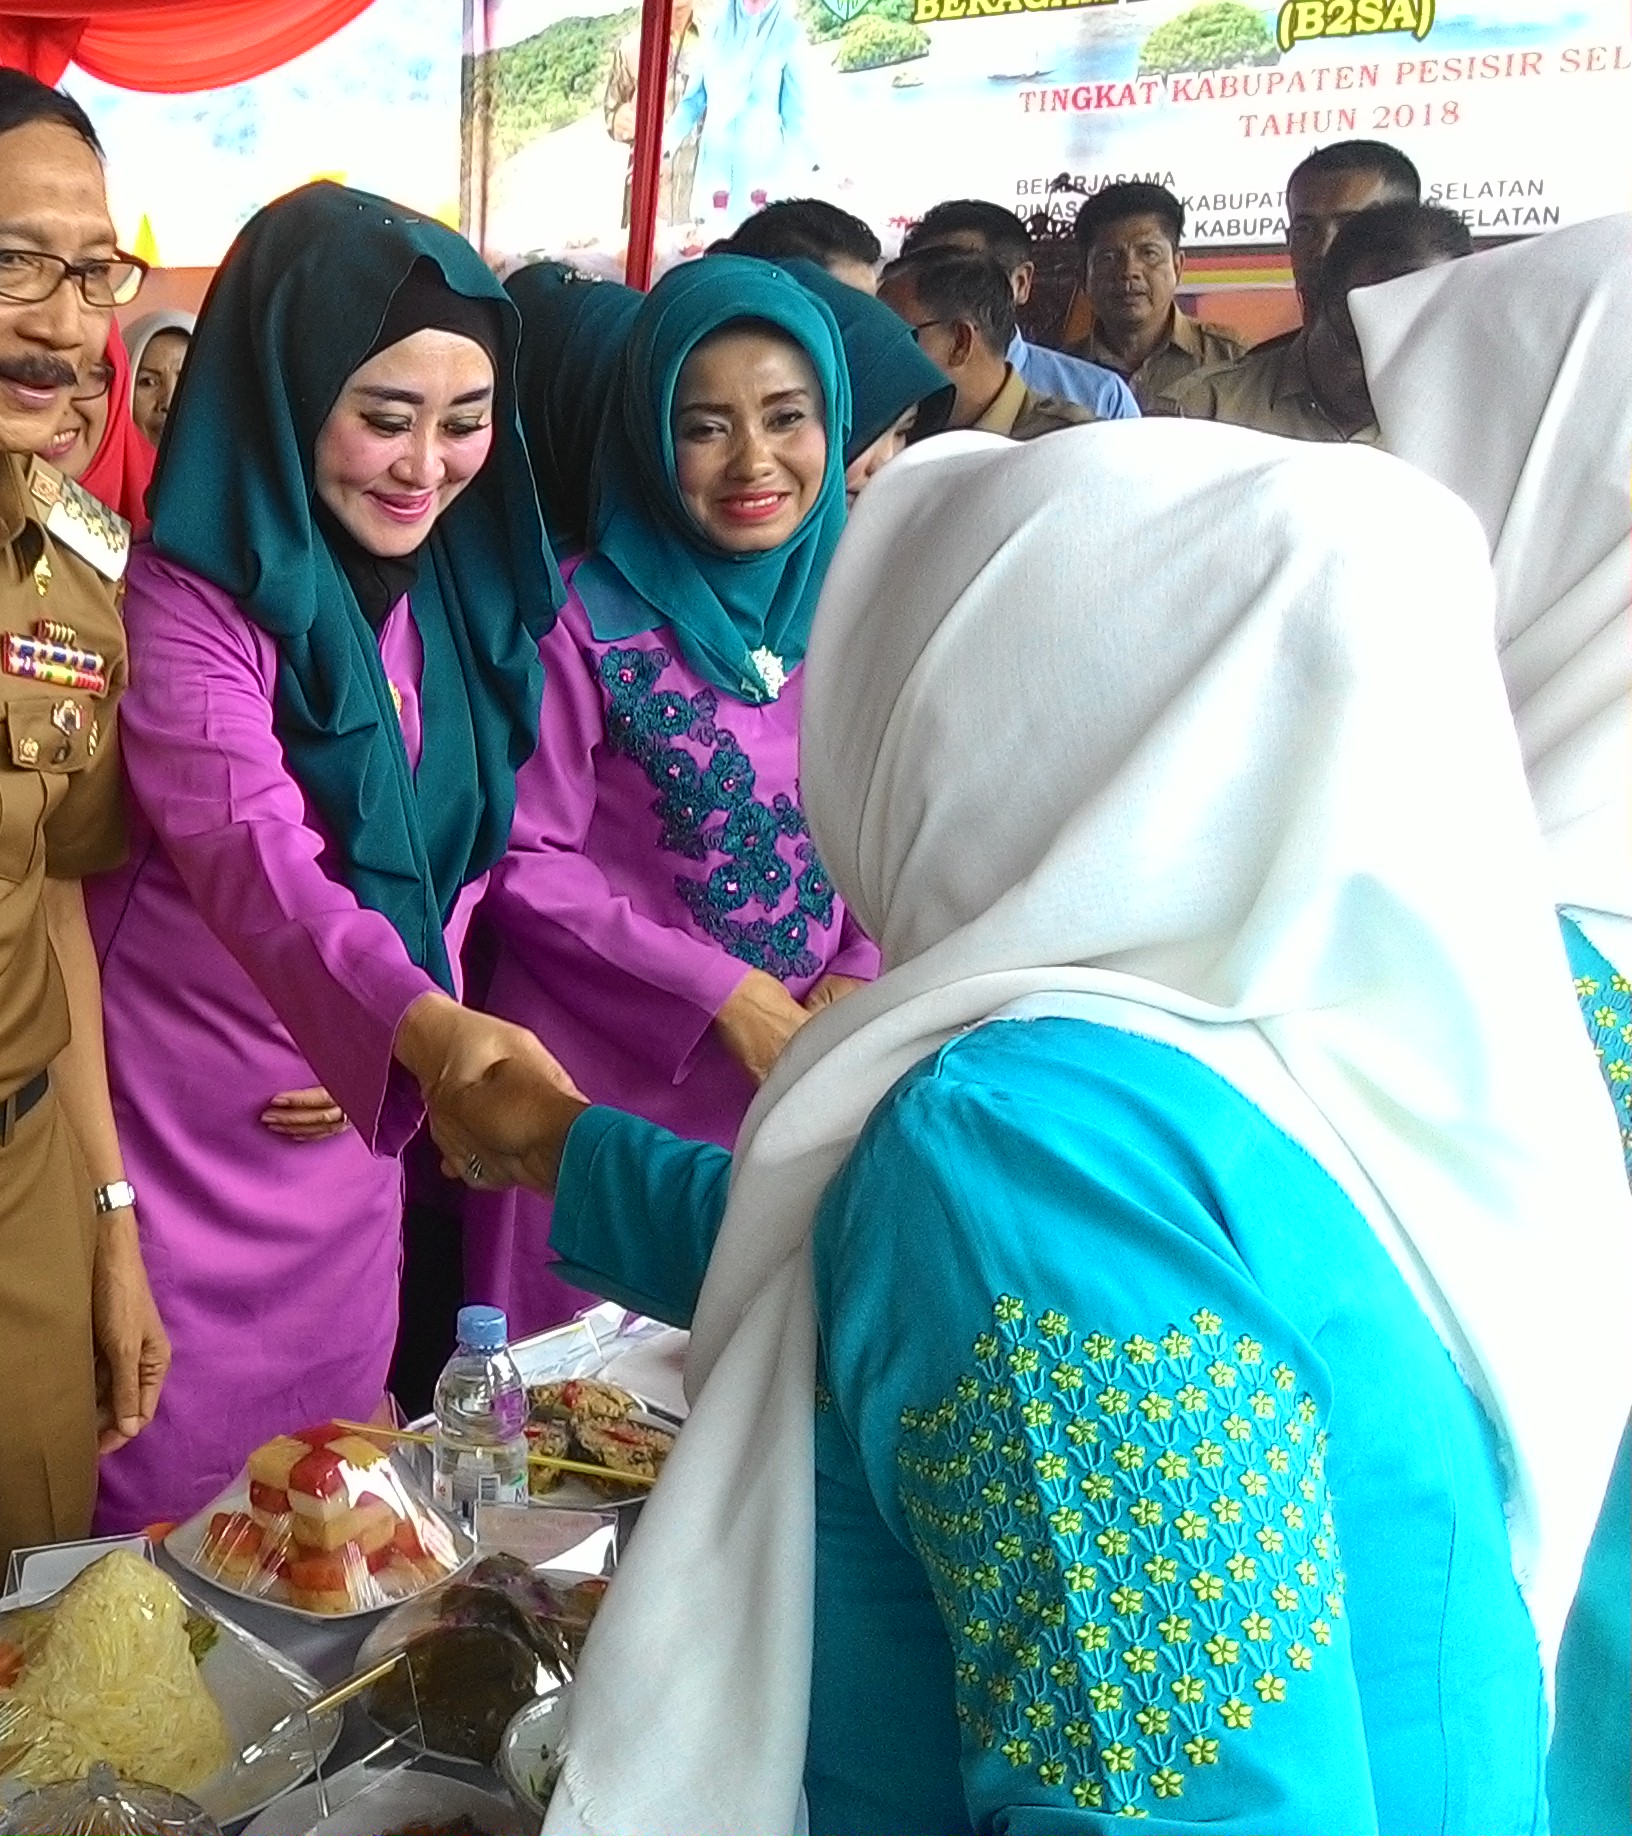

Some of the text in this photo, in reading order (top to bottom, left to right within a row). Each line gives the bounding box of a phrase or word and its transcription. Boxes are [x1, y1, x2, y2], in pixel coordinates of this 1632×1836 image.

[1276, 0, 1435, 53] (B2SA)
[1019, 81, 1159, 113] TINGKAT
[1171, 63, 1381, 103] KABUPATEN
[1396, 50, 1544, 85] PESISIR
[1238, 100, 1461, 138] TAHUN 2018
[1180, 191, 1288, 212] KABUPAT
[1429, 179, 1544, 201] SELATAN
[1194, 217, 1288, 239] KABUPA
[1450, 205, 1560, 228] ELATAN
